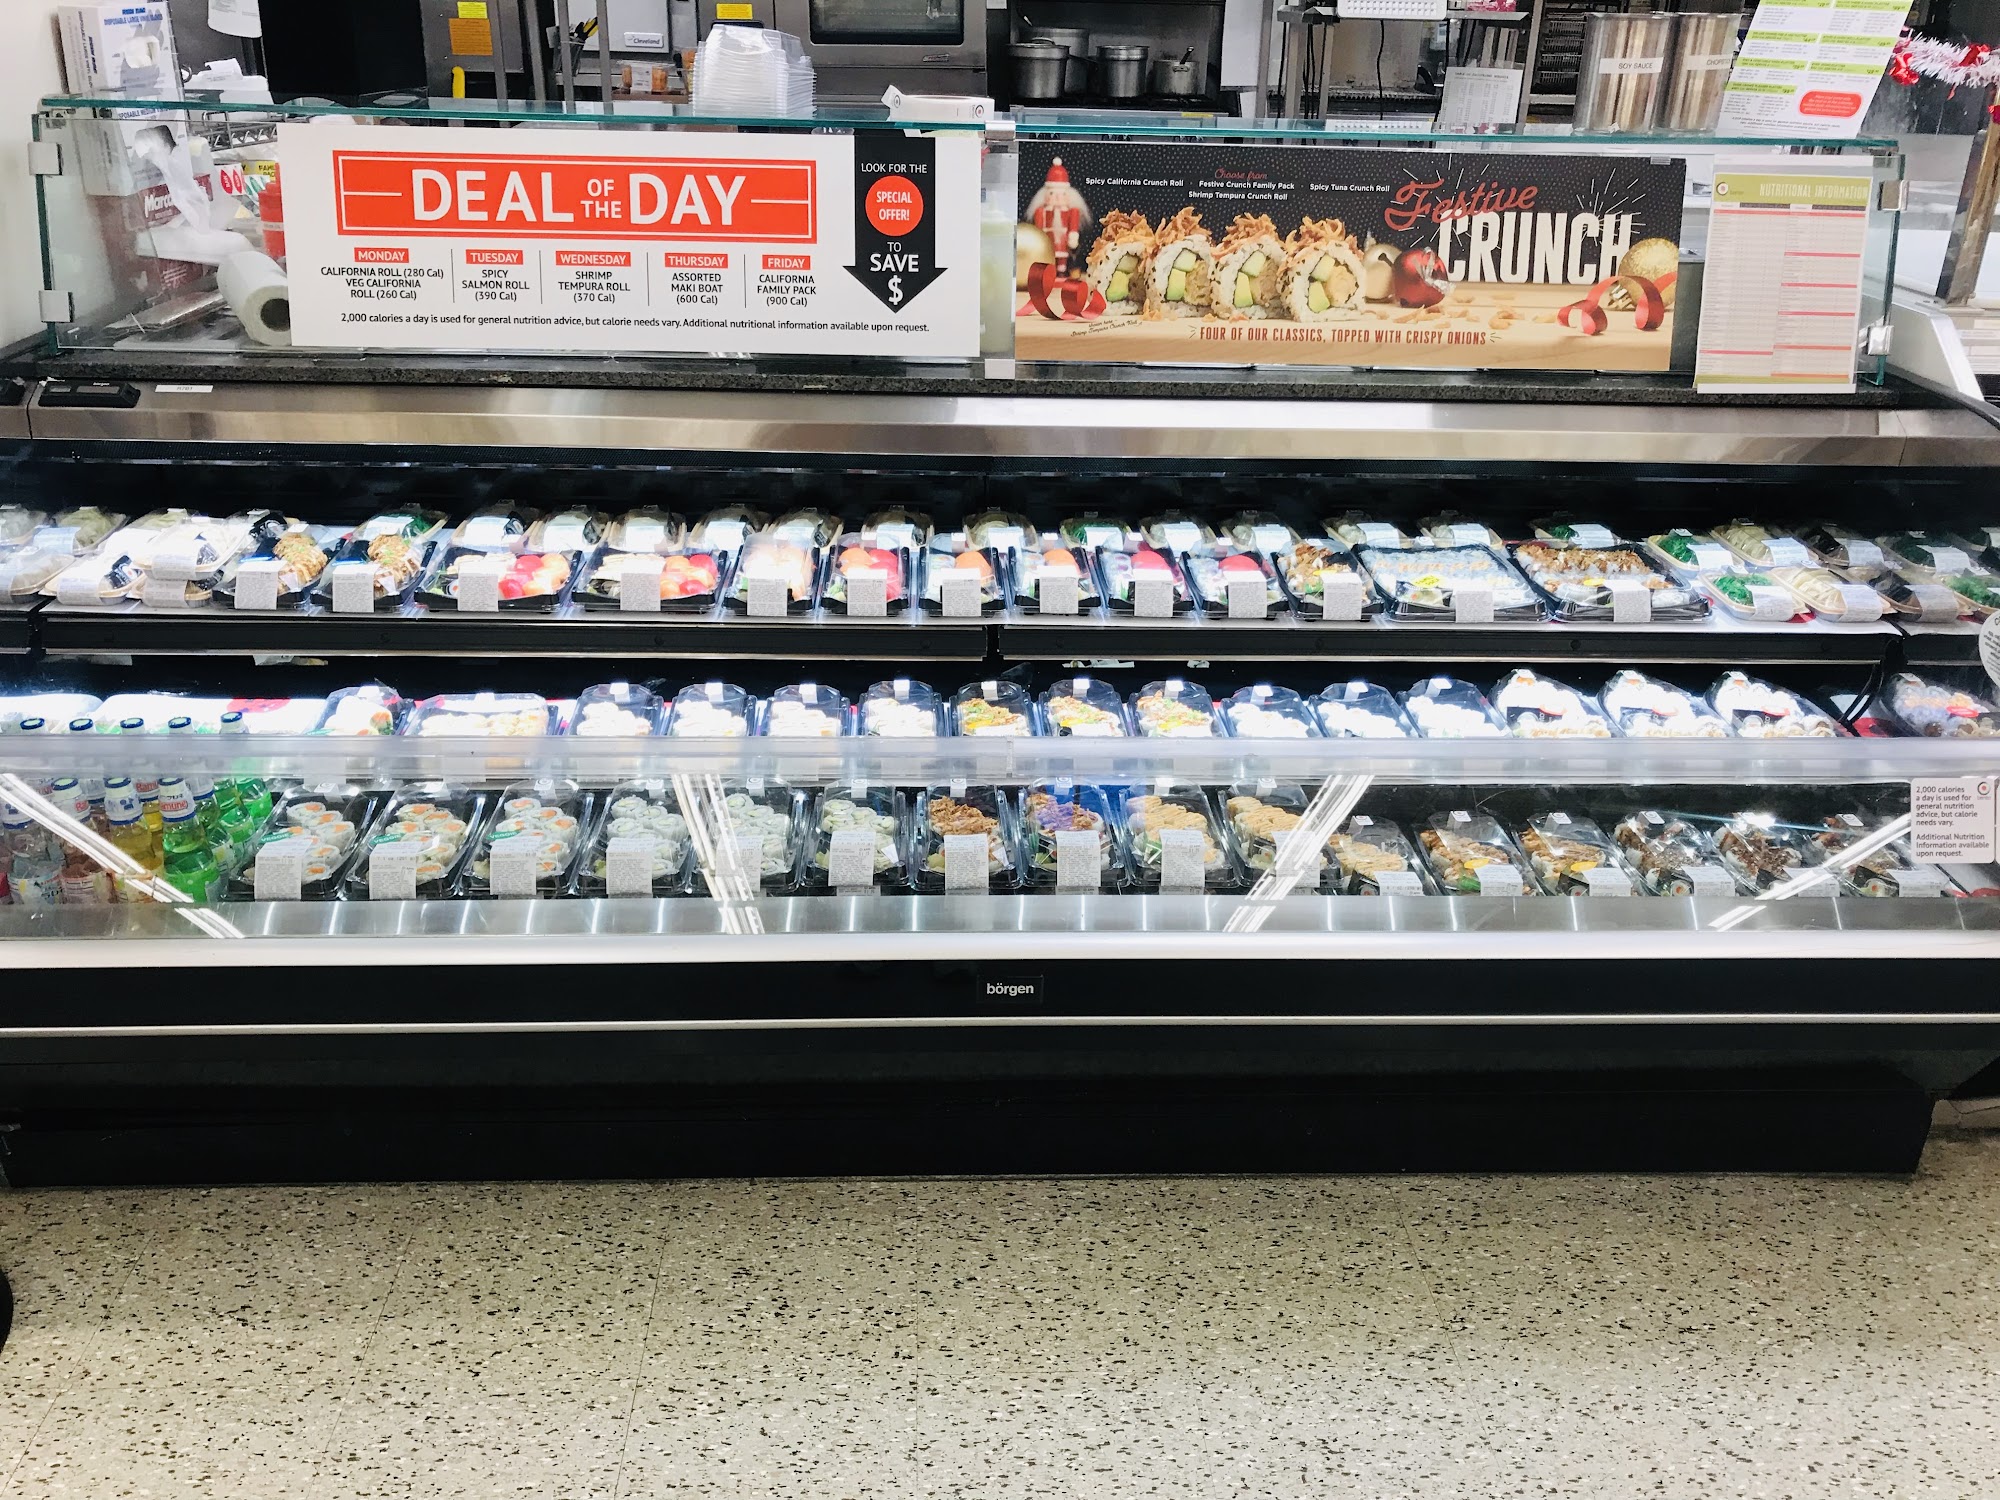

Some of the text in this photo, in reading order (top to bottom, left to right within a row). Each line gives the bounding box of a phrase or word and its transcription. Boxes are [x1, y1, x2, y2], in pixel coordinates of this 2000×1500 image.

[861, 163, 928, 174] LOOK FOR THE
[1214, 168, 1246, 180] Choose
[1086, 178, 1105, 187] Spicy
[1107, 178, 1141, 187] California
[1143, 179, 1168, 187] Crunch
[1199, 180, 1295, 191] Festive Crunch Family Pack
[1310, 184, 1329, 193] Spicy
[1330, 184, 1348, 192] Tuna
[1350, 184, 1375, 192] Crunch
[1760, 183, 1811, 197] NUTRITIONAL
[1815, 185, 1868, 199] INFORMATION
[412, 168, 746, 226] DEAL OF THE DAY
[876, 192, 912, 204] SPECIAL
[1188, 192, 1213, 201] Shrimp
[1215, 192, 1245, 202] Tempura
[1247, 192, 1272, 200] Crunch
[1384, 178, 1538, 230] Festive
[878, 208, 910, 222] OFFER!
[886, 242, 902, 252] TO
[1438, 209, 1632, 286] CRUNCH
[358, 250, 405, 262] MONDAY
[470, 252, 518, 264] TUESDAY
[560, 254, 626, 265] WEDNESDAY
[668, 256, 725, 268] THURSDAY
[768, 257, 806, 269] FRIDAY
[870, 254, 920, 273] SAVE
[321, 267, 444, 279] CALIFORNIA ROLL (280 Cal)
[482, 270, 508, 279] SPICY
[575, 271, 612, 280] SHRIMP
[672, 273, 722, 282] ASSORTED
[346, 278, 422, 288] VEG CALIFORNIA
[759, 274, 815, 284] CALIFORNIA
[462, 280, 530, 290] SALMON ROLL
[558, 282, 630, 292] TEMPURA ROLL
[671, 284, 723, 293] MAKI BOAT
[757, 285, 817, 296] FAMILY PACK
[888, 274, 904, 306] $
[350, 290, 418, 301] ROLL (260 Cal)
[474, 291, 518, 302] (390 Cal)
[573, 292, 616, 304] (370 Cal)
[676, 294, 718, 306] (600 Cal)
[766, 296, 808, 307] (900 Cal)
[341, 313, 367, 324] 2,000
[369, 313, 404, 323] calories
[413, 314, 429, 325] day
[430, 314, 438, 323] is
[440, 314, 461, 324] used
[462, 314, 476, 324] for
[478, 314, 512, 326] general
[514, 314, 552, 324] nutrition
[554, 316, 584, 326] advice,
[586, 316, 600, 325] but
[602, 316, 632, 326] calorie
[634, 317, 660, 327] needs
[661, 320, 682, 330] vary.
[683, 318, 728, 328] Additional
[730, 319, 776, 330] nutritional
[778, 320, 828, 330] information
[830, 321, 869, 331] available
[871, 324, 892, 334] upon
[895, 322, 930, 334] request.
[1200, 326, 1486, 345] FOUR OF OUR CLASSICS, TOPPED WITH CRISPY ONIONS
[260, 832, 290, 844] VEGGIE
[488, 830, 518, 840] VEGGIE
[986, 982, 1034, 996] börgen
